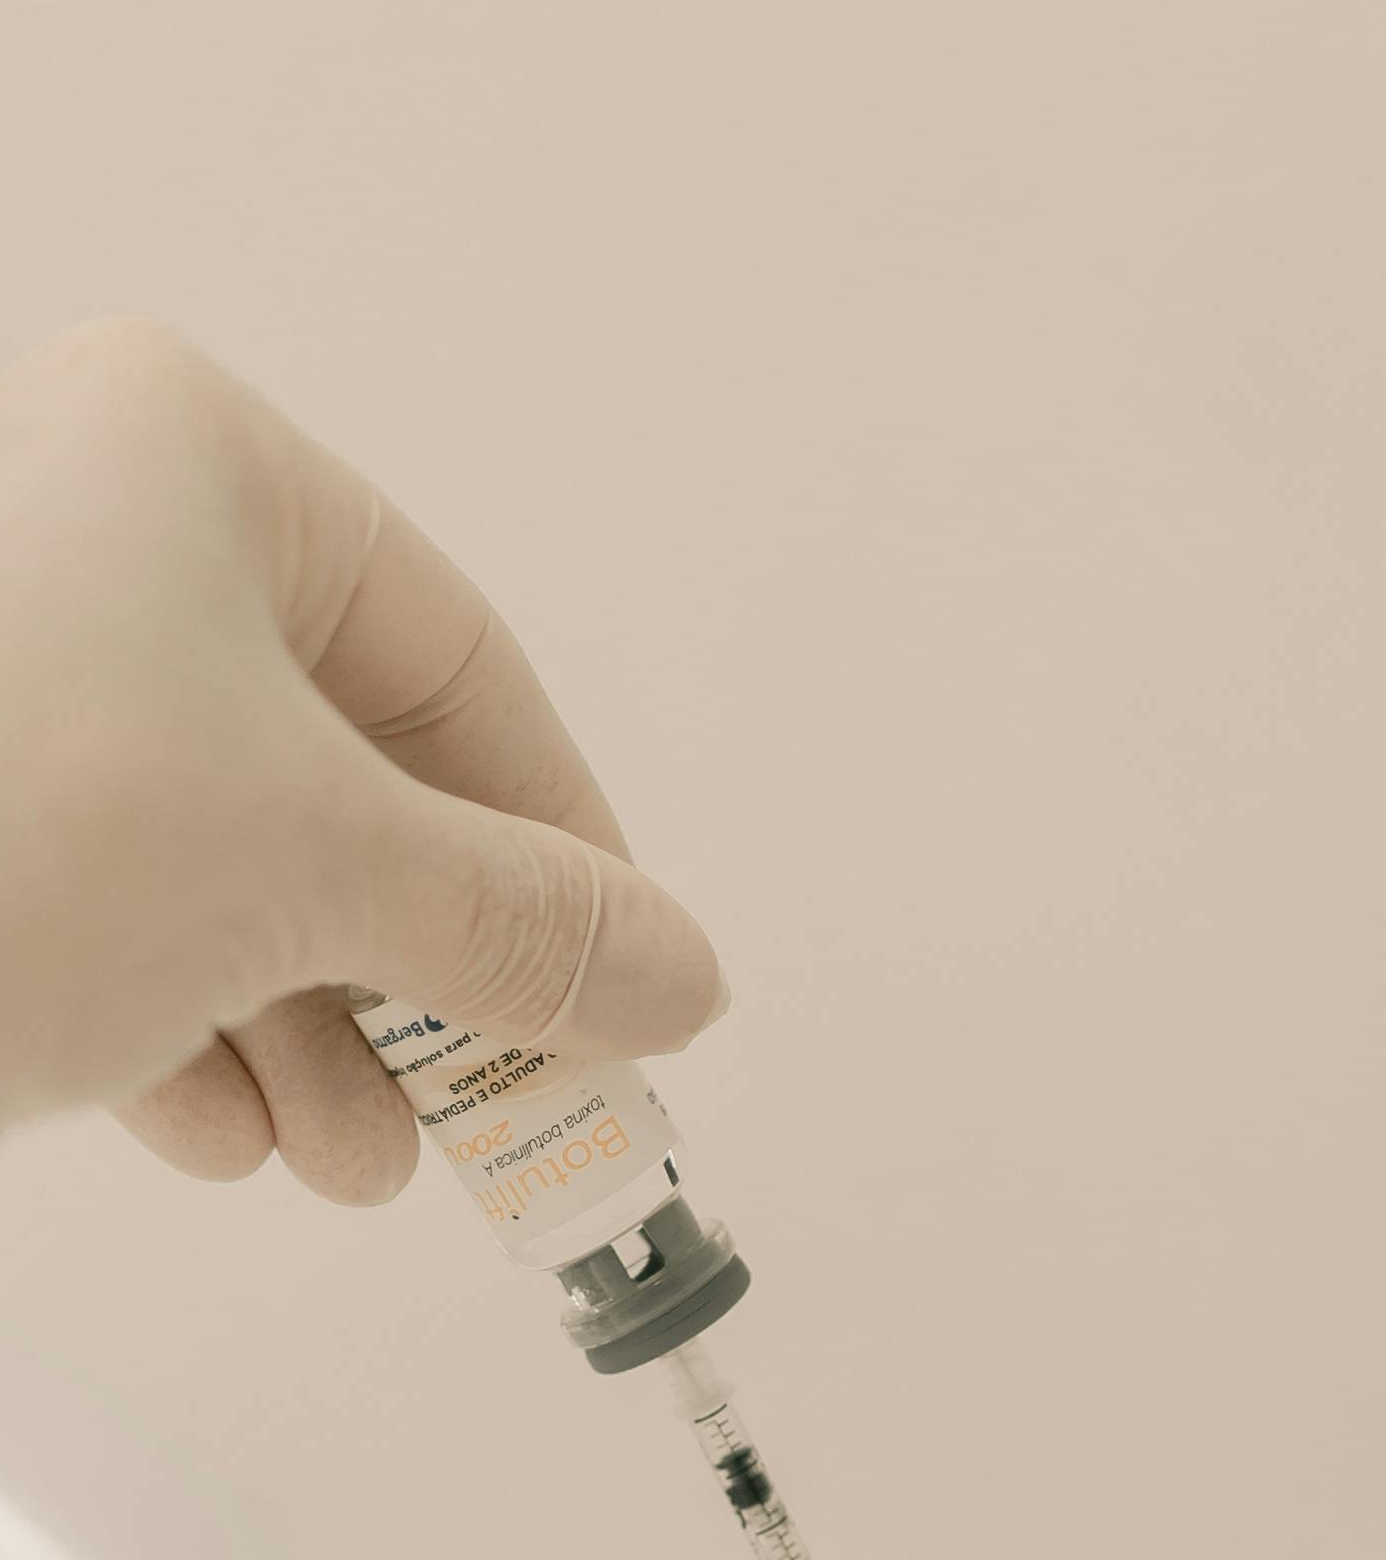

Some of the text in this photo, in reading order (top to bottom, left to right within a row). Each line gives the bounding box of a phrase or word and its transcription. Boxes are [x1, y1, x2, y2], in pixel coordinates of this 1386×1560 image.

[407, 1036, 472, 1072] para solução
[448, 1048, 523, 1095] DE 2 ANOS
[489, 1052, 545, 1095] ADULTO
[477, 1089, 489, 1102] E
[565, 1094, 606, 1130] toxina
[496, 1124, 564, 1170] botulínica
[474, 1114, 631, 1222] Botulift
[481, 1163, 495, 1177] A
